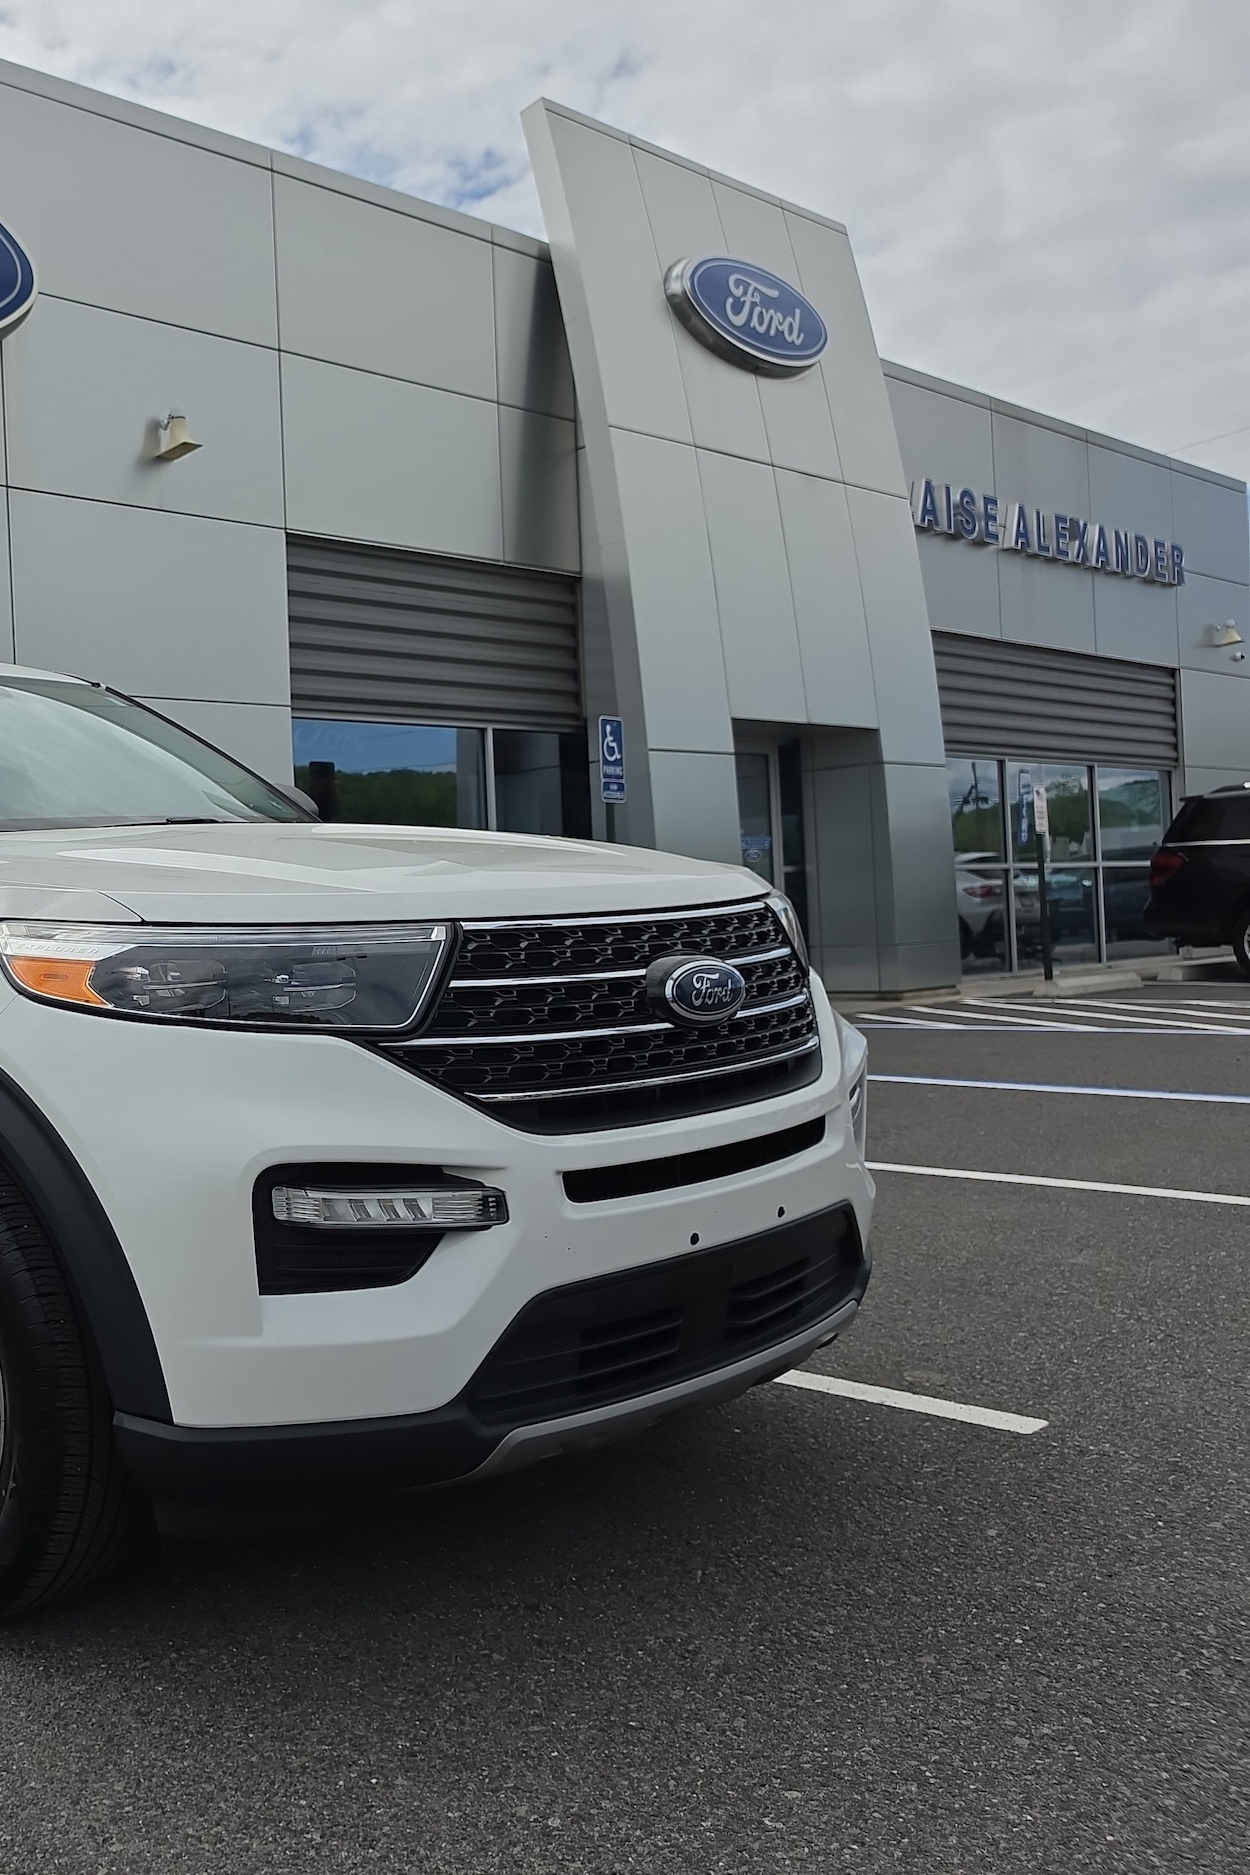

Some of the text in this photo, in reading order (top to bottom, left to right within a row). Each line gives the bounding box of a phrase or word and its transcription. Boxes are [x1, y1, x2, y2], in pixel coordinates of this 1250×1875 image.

[725, 273, 804, 346] Ford
[915, 477, 1185, 586] AISE ALEXANDER
[15, 942, 100, 955] EXPLORER
[692, 973, 734, 1006] Ford
